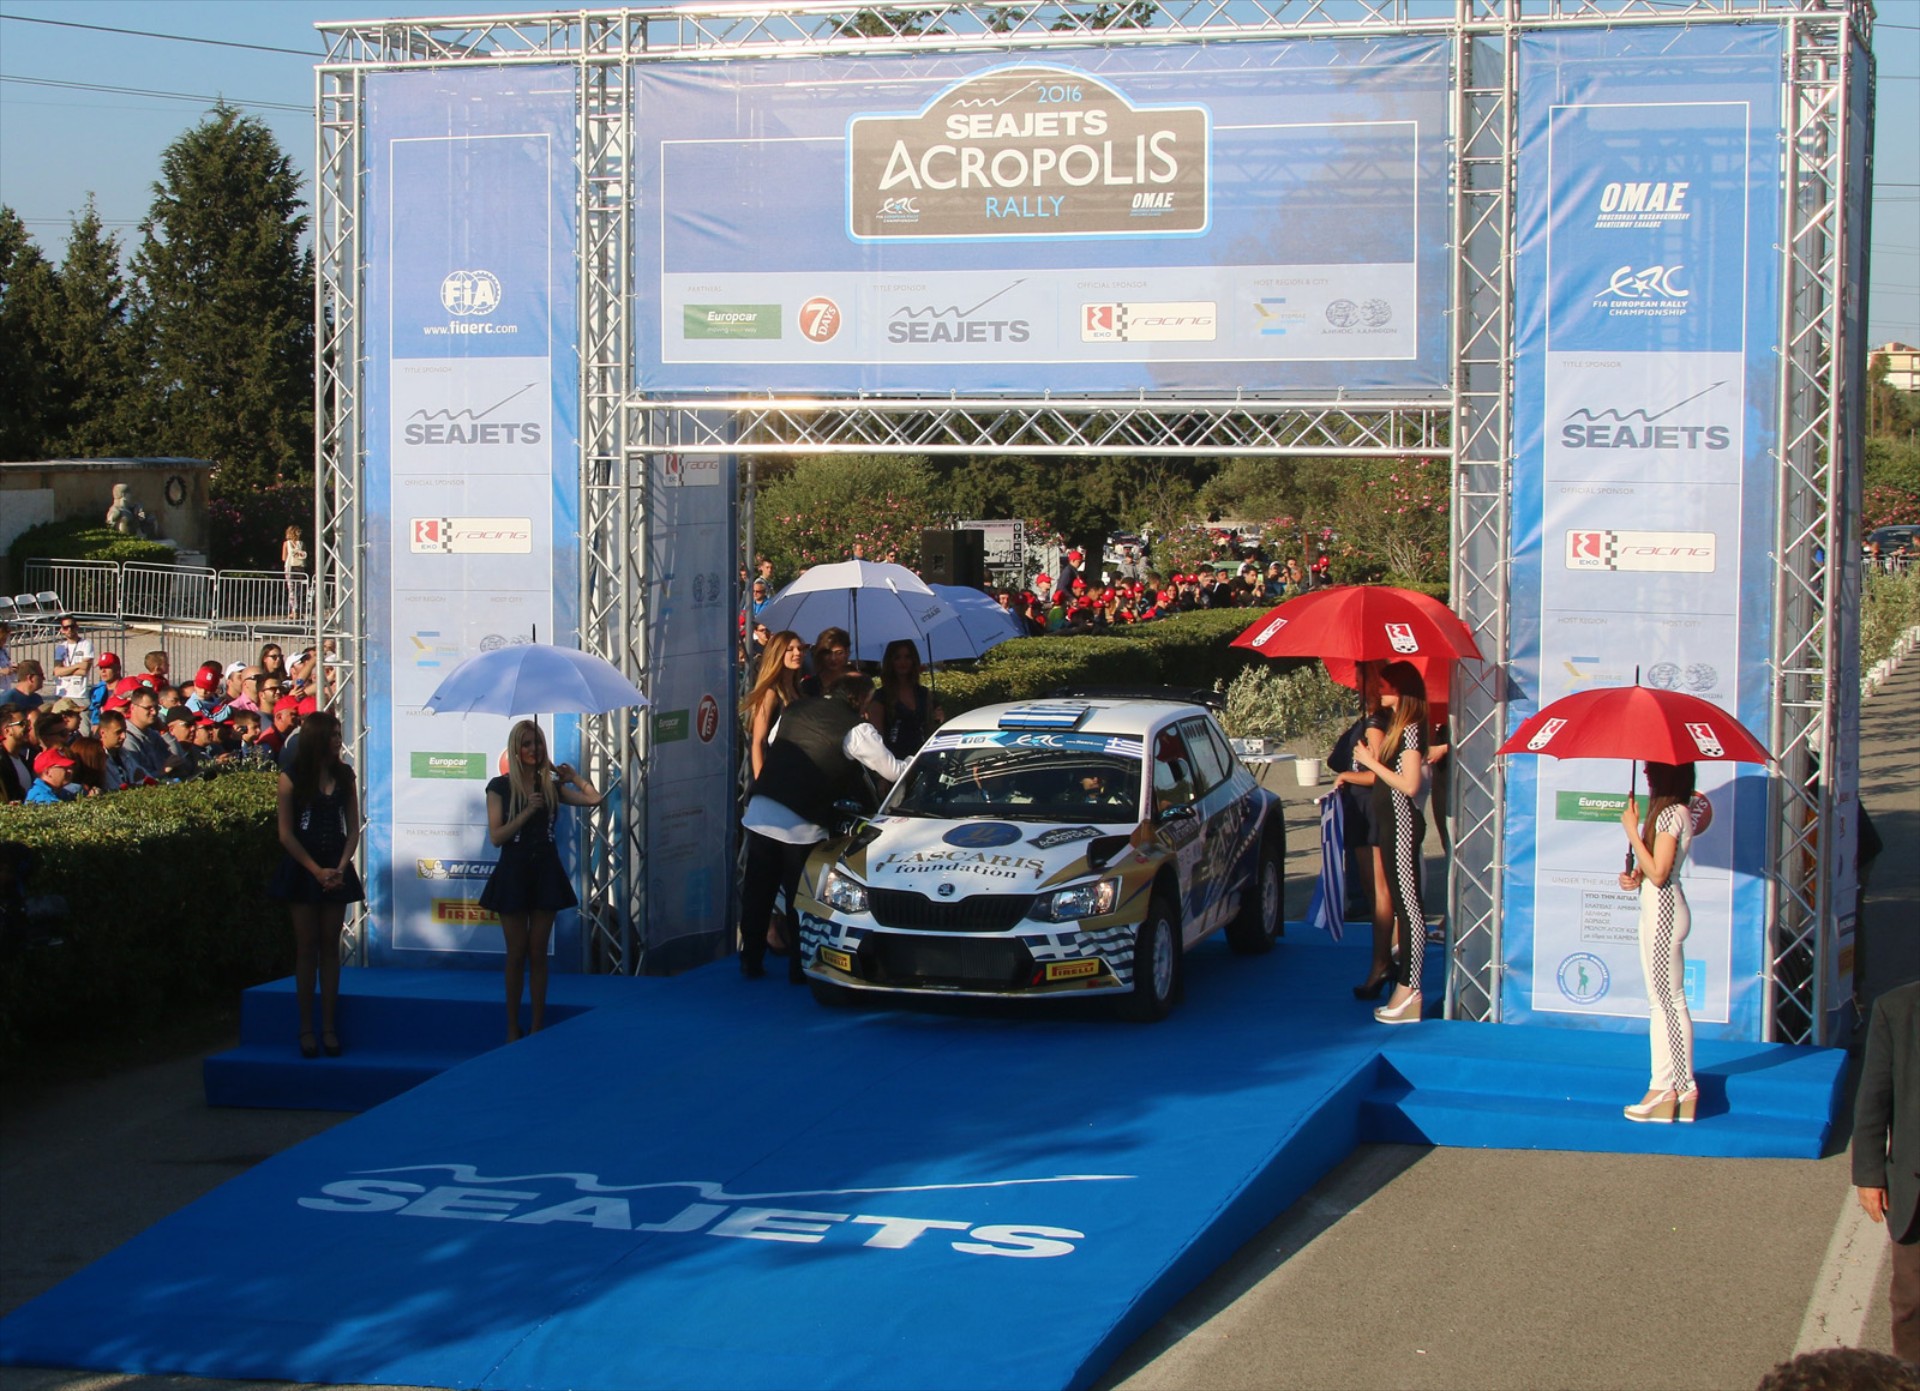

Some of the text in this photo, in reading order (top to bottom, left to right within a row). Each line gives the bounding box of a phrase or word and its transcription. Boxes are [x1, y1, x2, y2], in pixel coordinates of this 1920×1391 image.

[1037, 86, 1083, 104] 2016
[945, 109, 1108, 140] SEAJETS
[878, 130, 1178, 190] ACROPOLIS
[1131, 192, 1176, 209] OMAE
[1599, 182, 1691, 212] OMAE
[985, 195, 1066, 218] RALLY
[873, 284, 927, 292] TITLE SPONSOR
[1077, 280, 1148, 290] OFFICIAL SPONSOR
[707, 311, 757, 324] Europcar
[806, 303, 836, 338] 7 DAYS
[423, 320, 518, 335] www.fiaerc.com
[887, 320, 1030, 344] SEAJETS
[404, 422, 541, 446] SEAJETS
[1561, 424, 1730, 450] SEAJETS
[429, 757, 468, 767] Europcar
[1578, 797, 1626, 809] Europcar
[885, 851, 1045, 870] LASCARIS
[894, 862, 1018, 879] foundation
[1552, 875, 1579, 884] UNDER
[438, 902, 500, 921] PIRELL
[1051, 962, 1095, 977] PIRELLI
[296, 1179, 1087, 1259] SEAJETS
